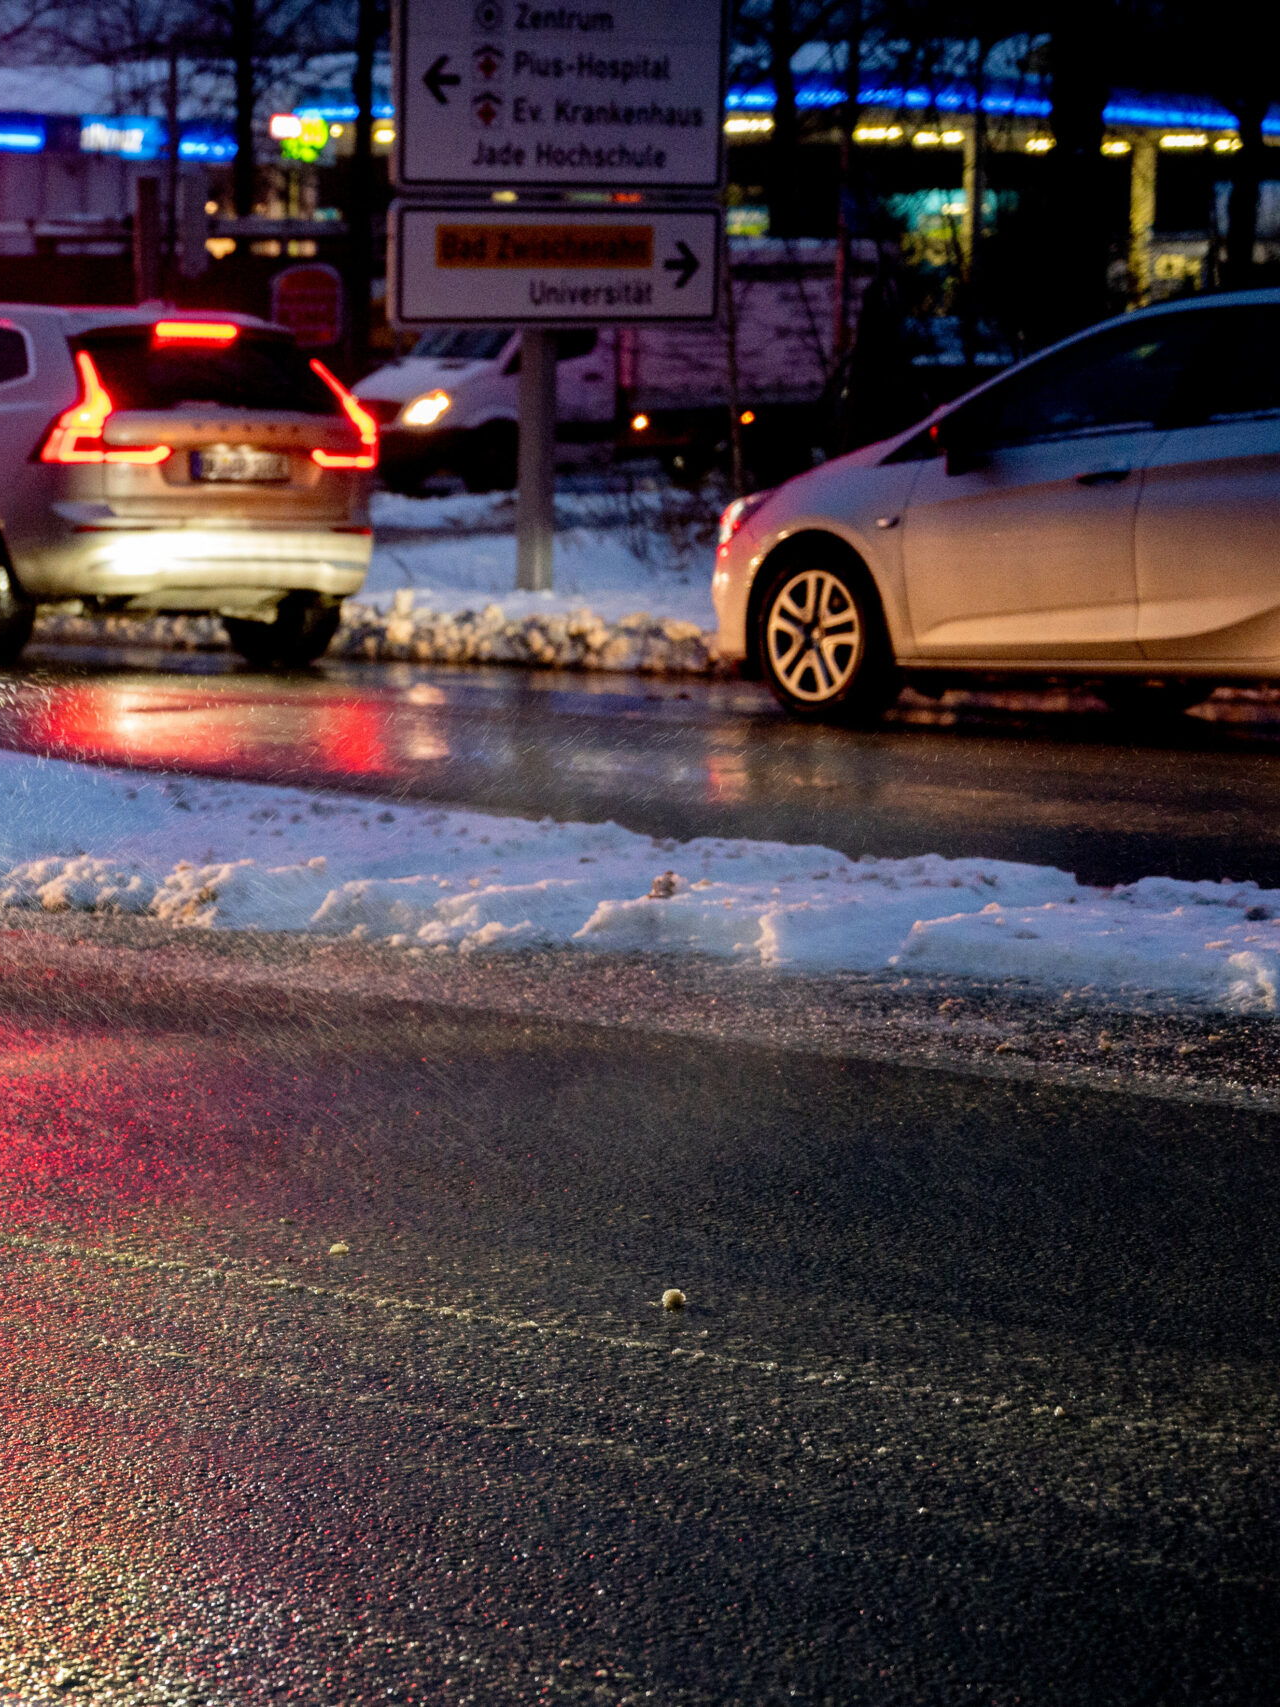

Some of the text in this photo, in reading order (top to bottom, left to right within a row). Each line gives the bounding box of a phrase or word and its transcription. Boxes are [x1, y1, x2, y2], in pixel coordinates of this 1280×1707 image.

[514, 2, 615, 31] Zentrum
[514, 50, 670, 84] Pius-Hospital
[554, 98, 705, 127] Krankenhaus
[472, 138, 668, 168] Jade Hochschule
[529, 278, 653, 306] Universität
